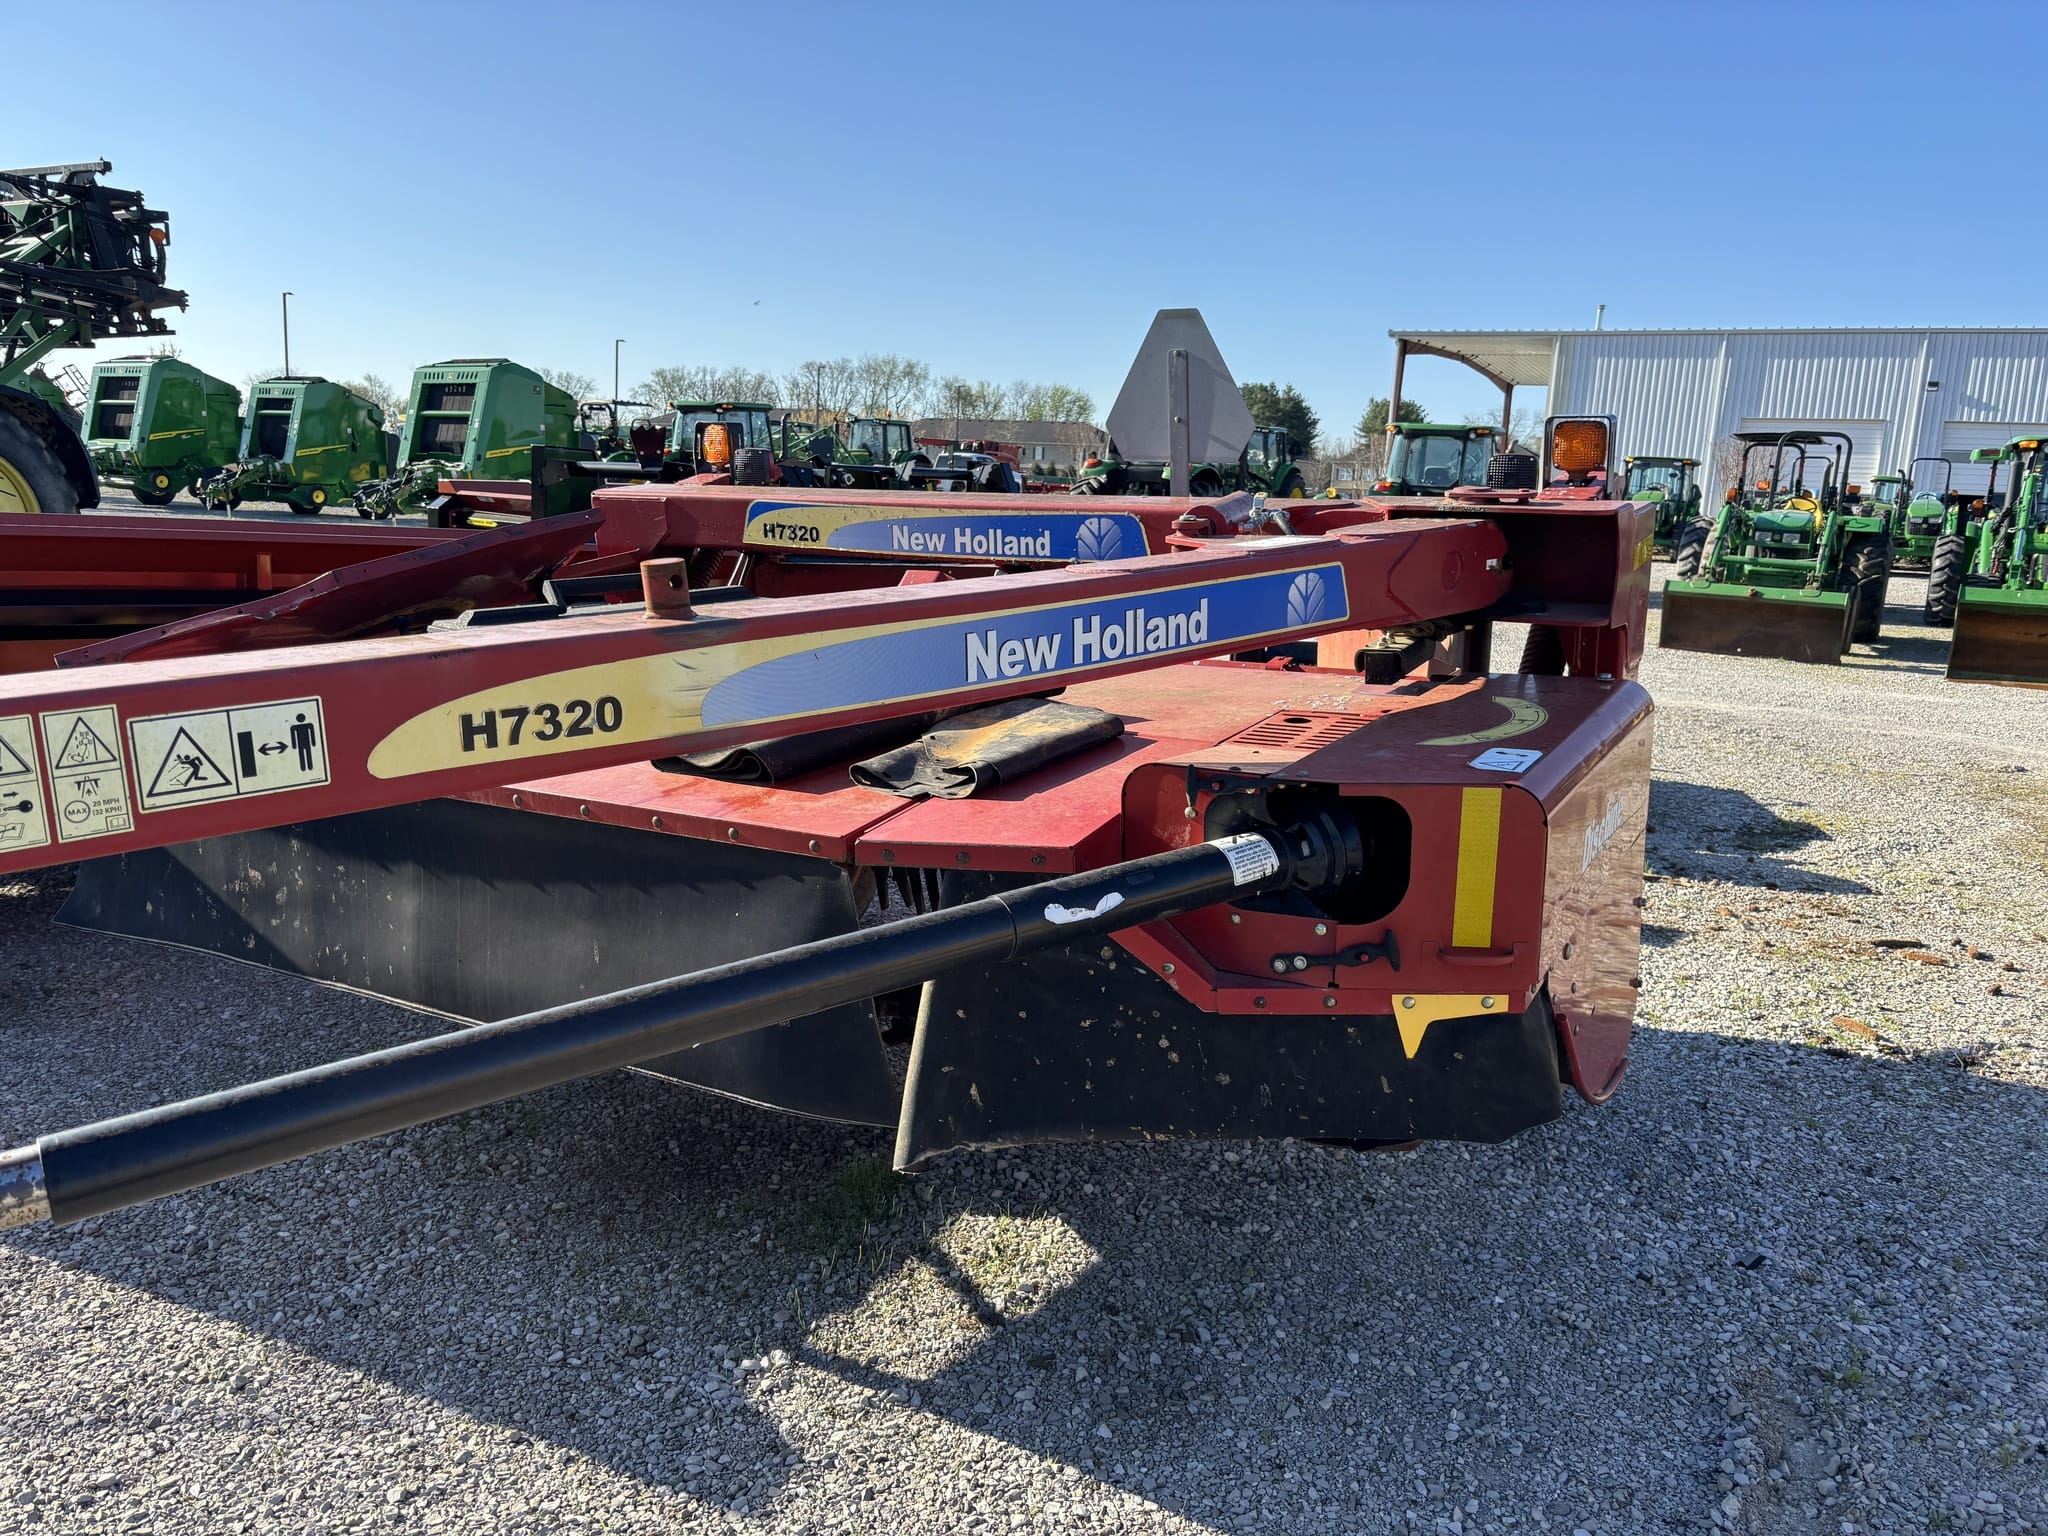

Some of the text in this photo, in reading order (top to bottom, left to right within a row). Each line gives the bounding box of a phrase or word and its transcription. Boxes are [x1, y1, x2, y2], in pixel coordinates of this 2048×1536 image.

[762, 521, 820, 543] H7320
[892, 524, 1051, 557] New Holland
[965, 597, 1209, 683] New Holland
[459, 694, 624, 752] H7320
[67, 807, 88, 816] MAX
[102, 798, 120, 806] MPH
[105, 806, 122, 814] KPH)
[1581, 796, 1624, 875] Discbine
